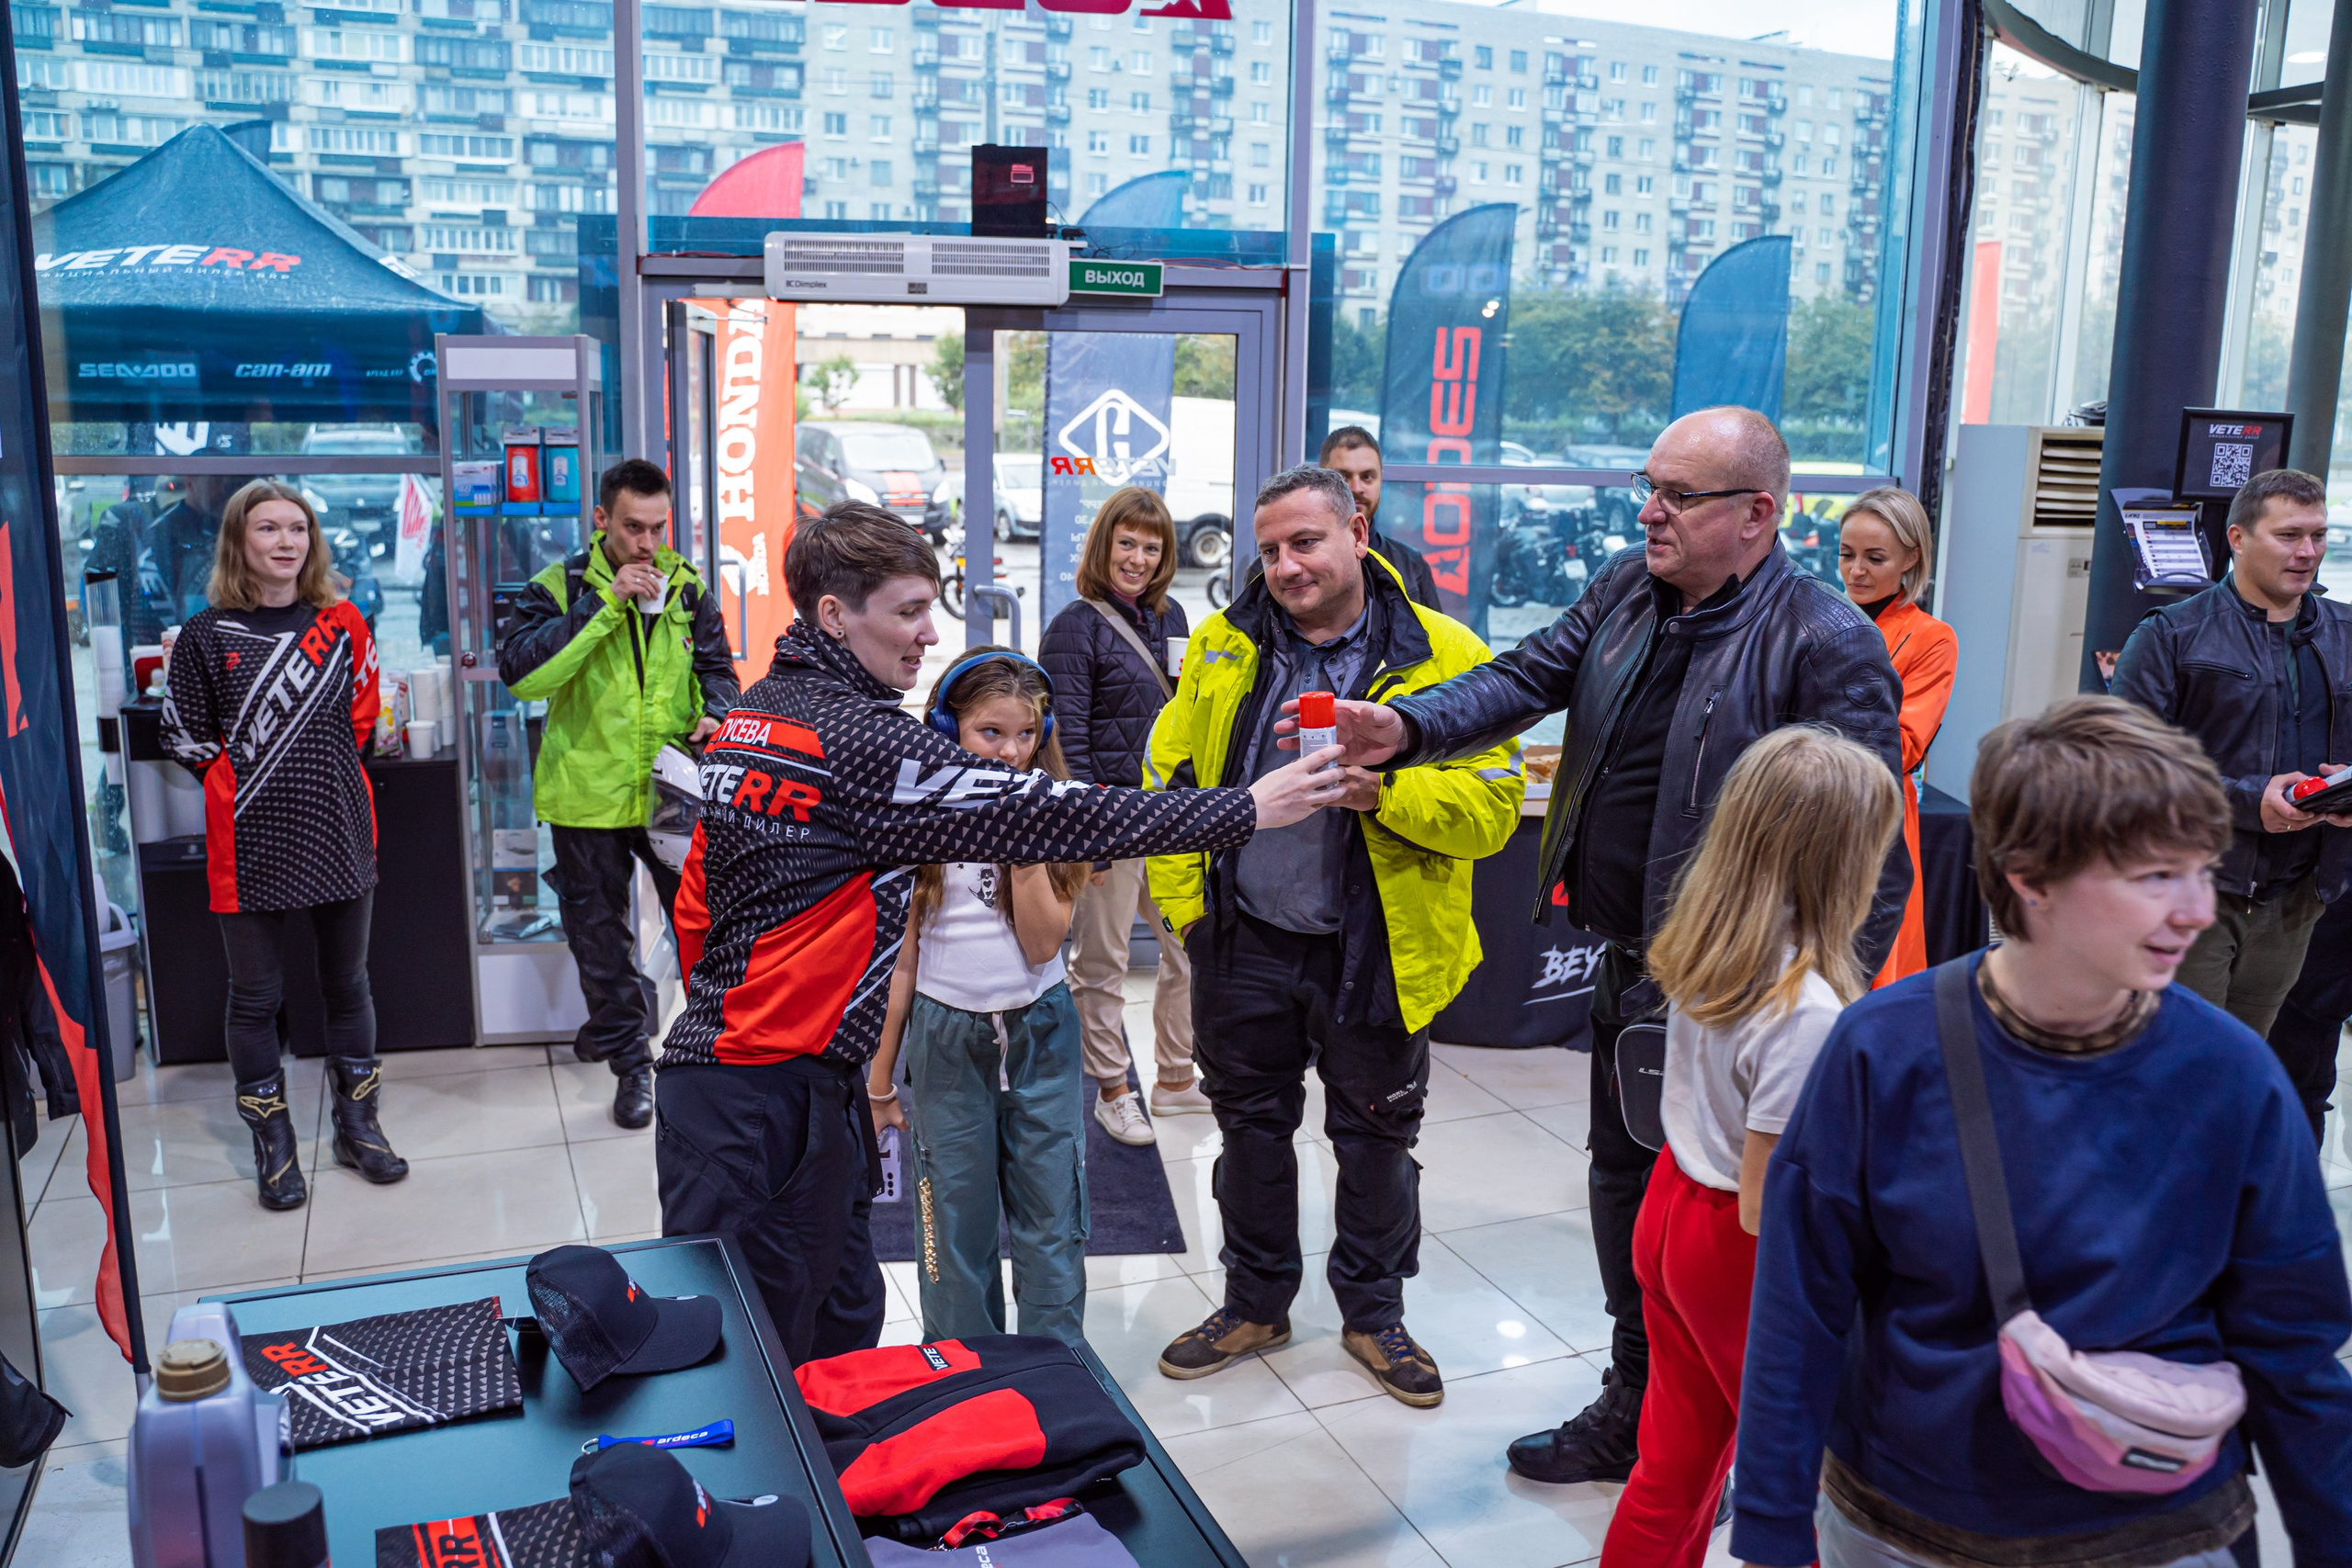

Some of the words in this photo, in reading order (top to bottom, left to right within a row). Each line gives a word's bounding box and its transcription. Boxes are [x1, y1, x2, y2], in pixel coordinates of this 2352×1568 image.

[35, 244, 301, 272] VETERR
[40, 265, 173, 278] ФИЦИАЛЬНЫЙ
[1085, 269, 1145, 288] ВЫХОД
[795, 280, 827, 288] Dimplex
[235, 363, 332, 378] can-am
[718, 299, 764, 523] HONDA
[2209, 423, 2263, 435] VETERR
[718, 718, 773, 747] ГУСЕВА
[743, 815, 810, 840] ДИЛЕР
[1532, 941, 1608, 989] BEY
[261, 1341, 406, 1427] VETERR
[657, 1431, 708, 1445] ardeca
